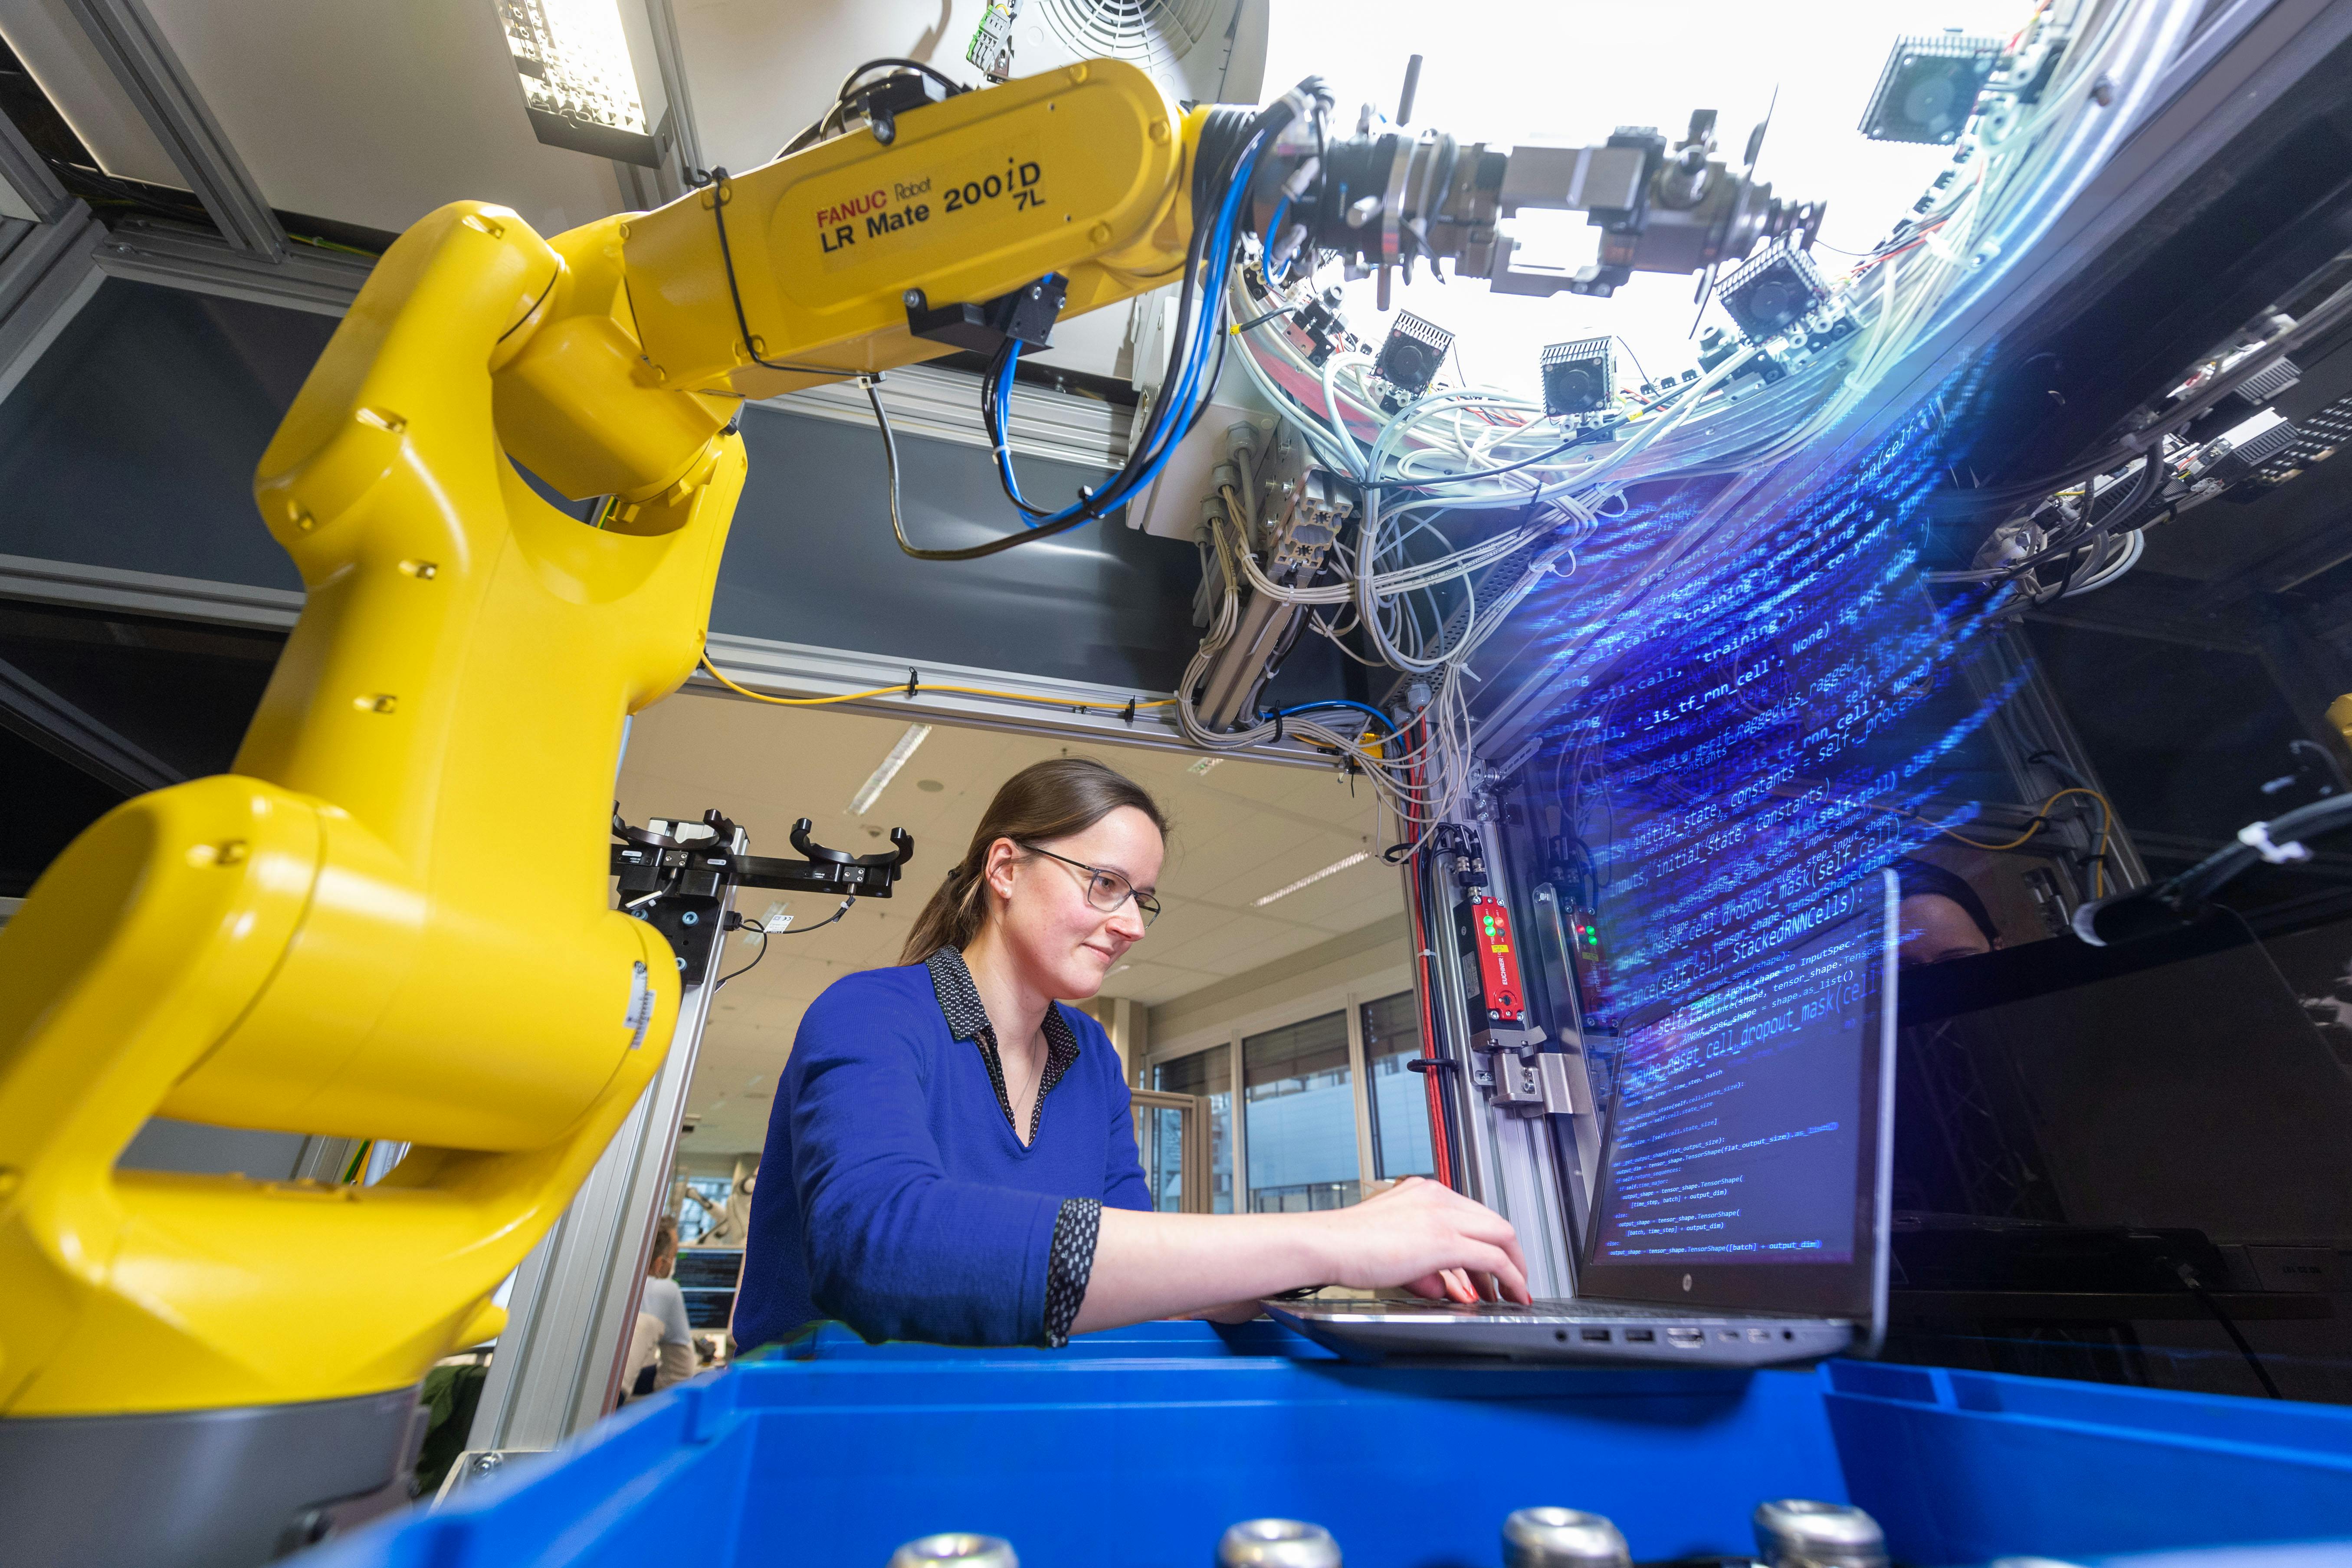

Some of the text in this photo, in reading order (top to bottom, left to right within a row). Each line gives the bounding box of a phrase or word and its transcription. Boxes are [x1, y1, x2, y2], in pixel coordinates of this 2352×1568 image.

[817, 177, 932, 228] FANUC Robot
[821, 157, 1041, 253] LR Mate 200iD
[1013, 189, 1045, 211] 7L
[1498, 958, 1508, 985] EUCHNER
[1674, 1078, 1702, 1091] time_step,
[1706, 1069, 1722, 1079] batch
[1623, 1122, 1647, 1132] state_size
[1654, 1101, 1713, 1123] self.cell.state_size
[1620, 1139, 1645, 1149] state_size
[1652, 1118, 1717, 1142] [self.cell.state_size]
[1617, 1166, 1641, 1175] output_dim
[1623, 1167, 1681, 1183] self.return_sequences:
[1623, 1191, 1653, 1200] output_shape
[1662, 1175, 1743, 1194] tensor_shape.TensorShape(
[1627, 1179, 1668, 1190] self.time_major:
[1631, 1199, 1660, 1209] [time_step,
[1663, 1195, 1681, 1204] batch]
[1690, 1188, 1727, 1200] output_dim)
[1658, 1209, 1740, 1223] tensor_shape.TensorShape(
[1686, 1222, 1724, 1231] output_dim)
[1649, 1243, 1757, 1254] tensor_shape.TensorShape([batch]
